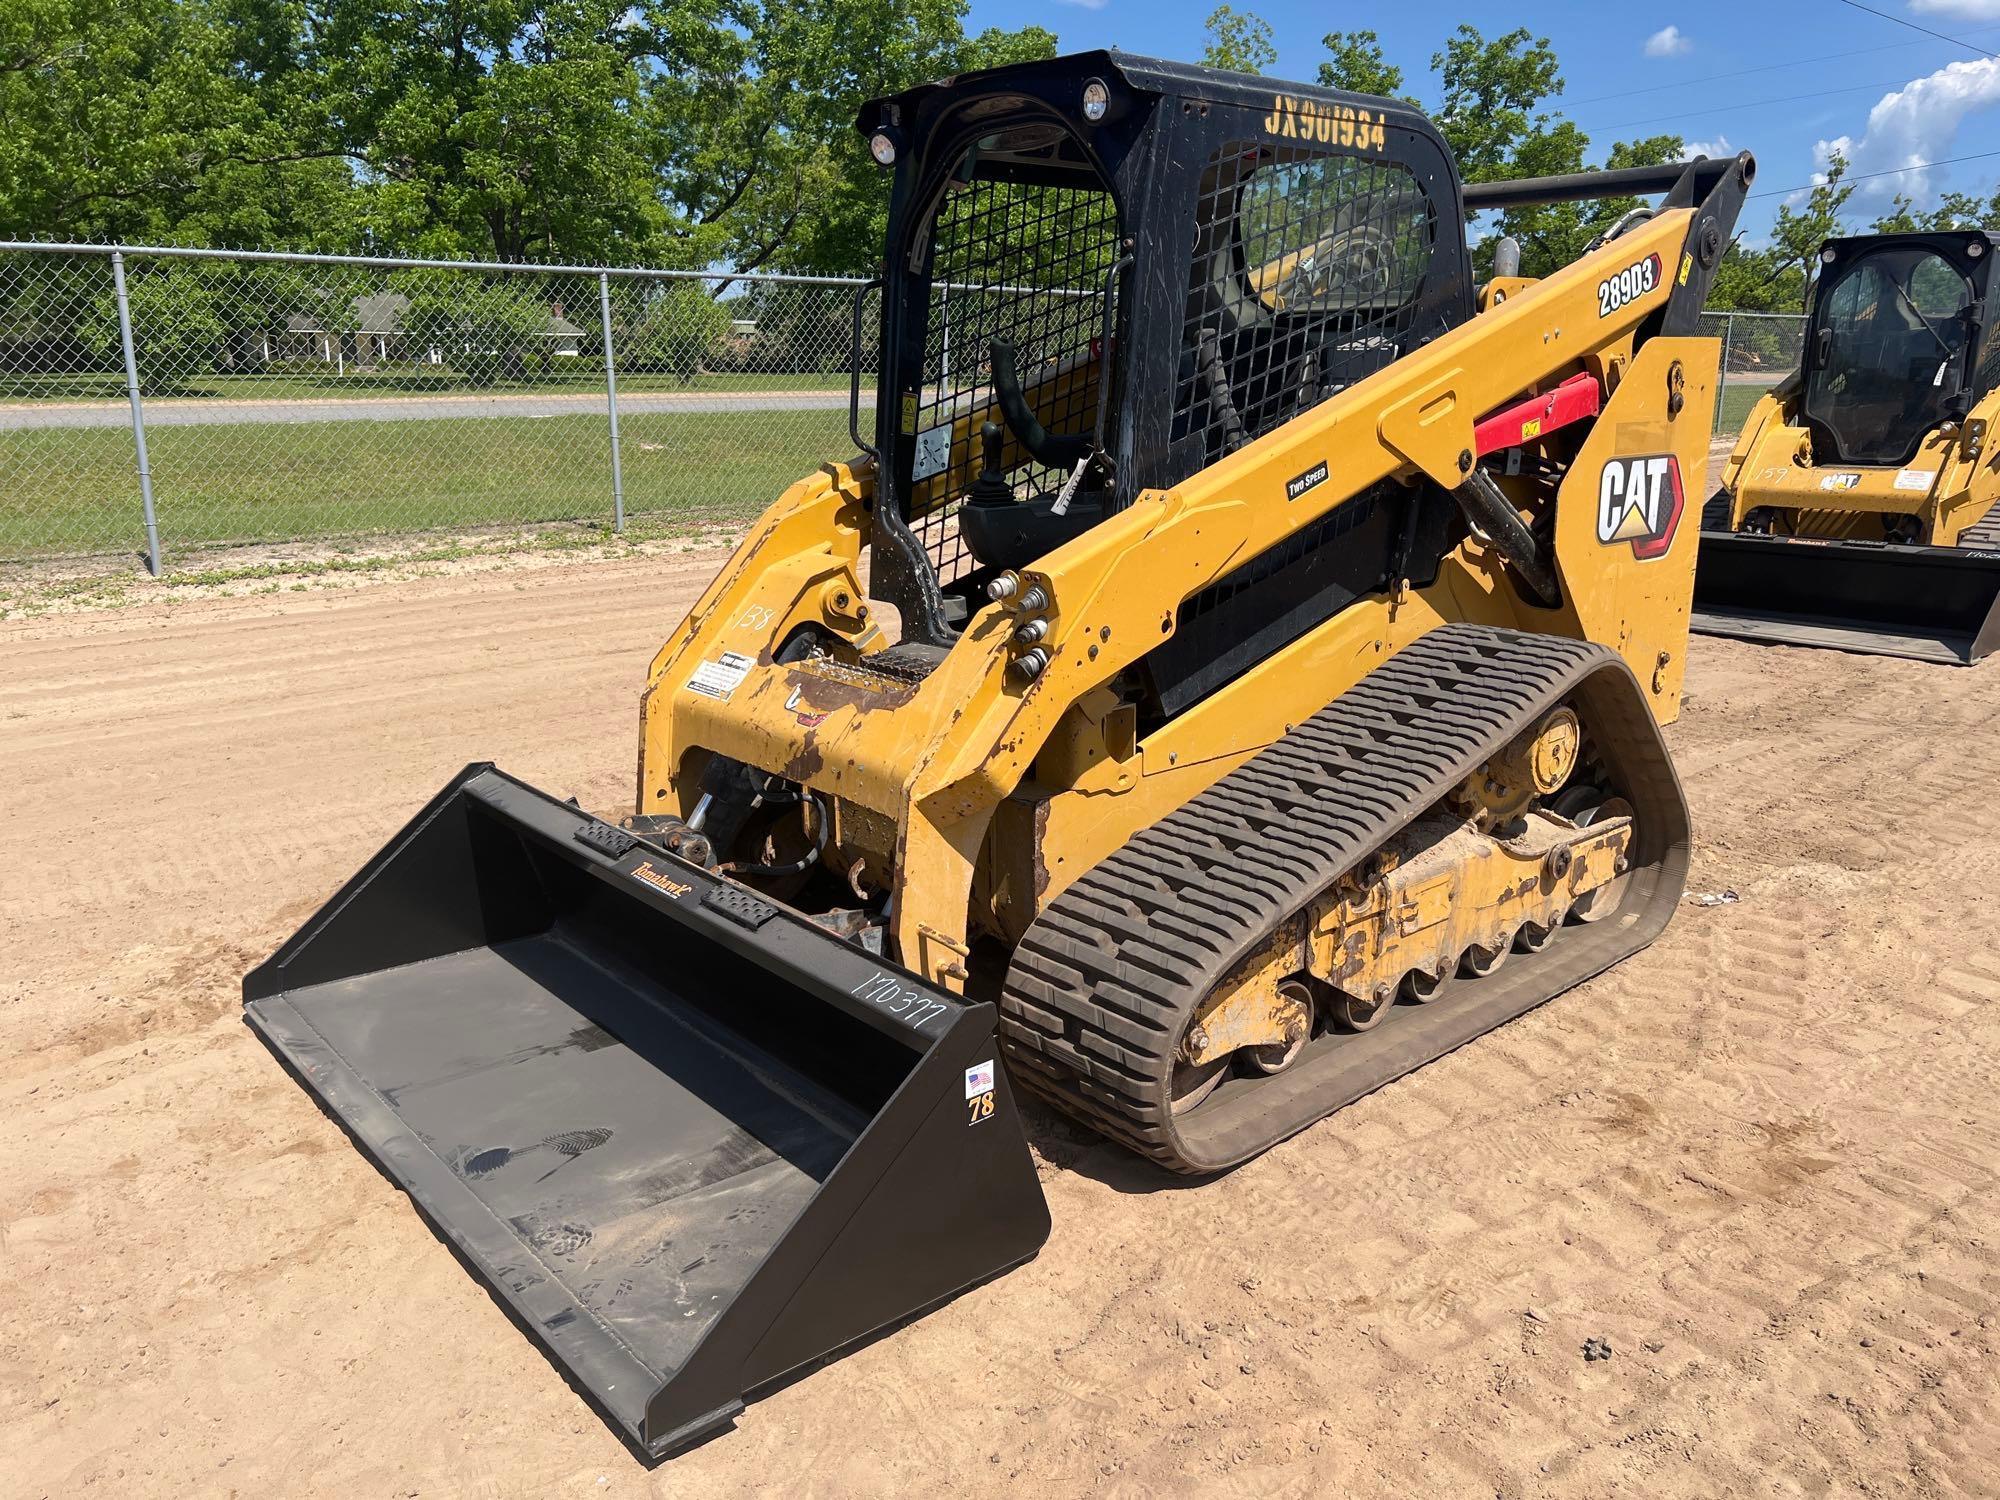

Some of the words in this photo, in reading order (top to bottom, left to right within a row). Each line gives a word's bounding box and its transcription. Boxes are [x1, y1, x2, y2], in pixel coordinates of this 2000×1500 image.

[1598, 256, 1654, 317] 289D3
[1598, 457, 1669, 542] CAT
[1755, 467, 1788, 485] 159
[731, 603, 776, 631] 138
[630, 861, 693, 897] Tomahawk
[850, 971, 948, 1030] 170377
